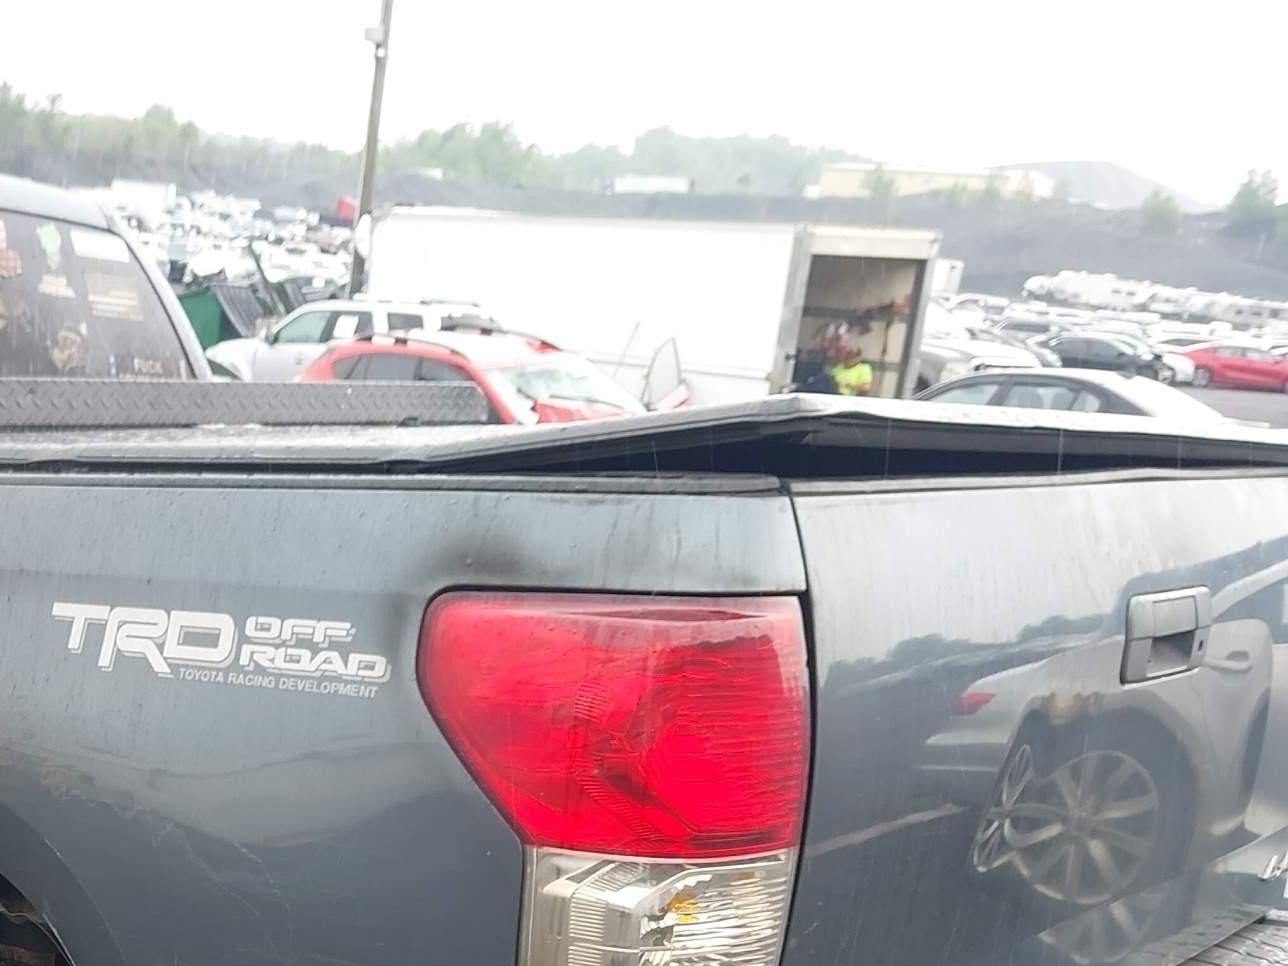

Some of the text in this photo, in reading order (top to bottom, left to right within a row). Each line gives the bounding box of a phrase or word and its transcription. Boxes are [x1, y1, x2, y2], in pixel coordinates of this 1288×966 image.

[51, 602, 238, 677] TRD
[245, 616, 356, 647] OFF
[239, 644, 392, 683] ROAD
[178, 667, 380, 699] TOYOTA RACING DEVELOPMENT
